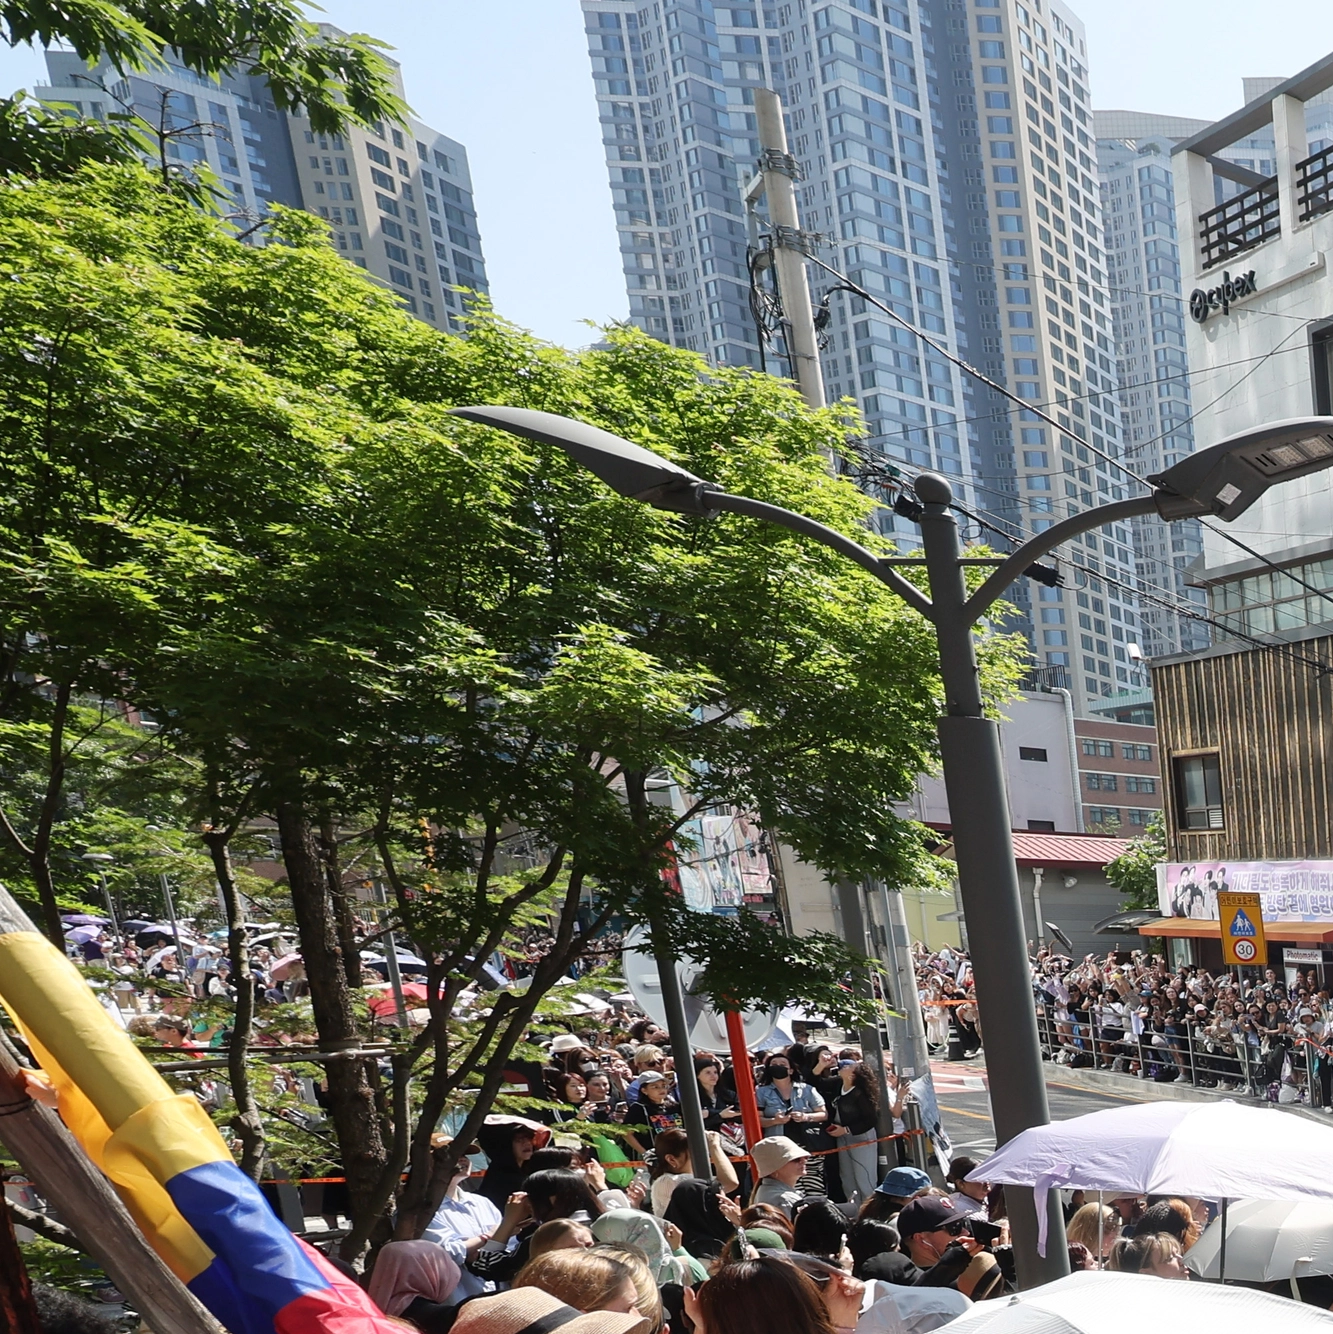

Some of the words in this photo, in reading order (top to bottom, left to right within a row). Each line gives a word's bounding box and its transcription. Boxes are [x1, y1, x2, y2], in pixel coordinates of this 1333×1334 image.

[1206, 270, 1257, 316] cybex
[1232, 871, 1270, 891] 기다림도
[1271, 871, 1309, 892] 행복하게
[1267, 893, 1287, 913] 방탄
[1237, 944, 1253, 956] 30
